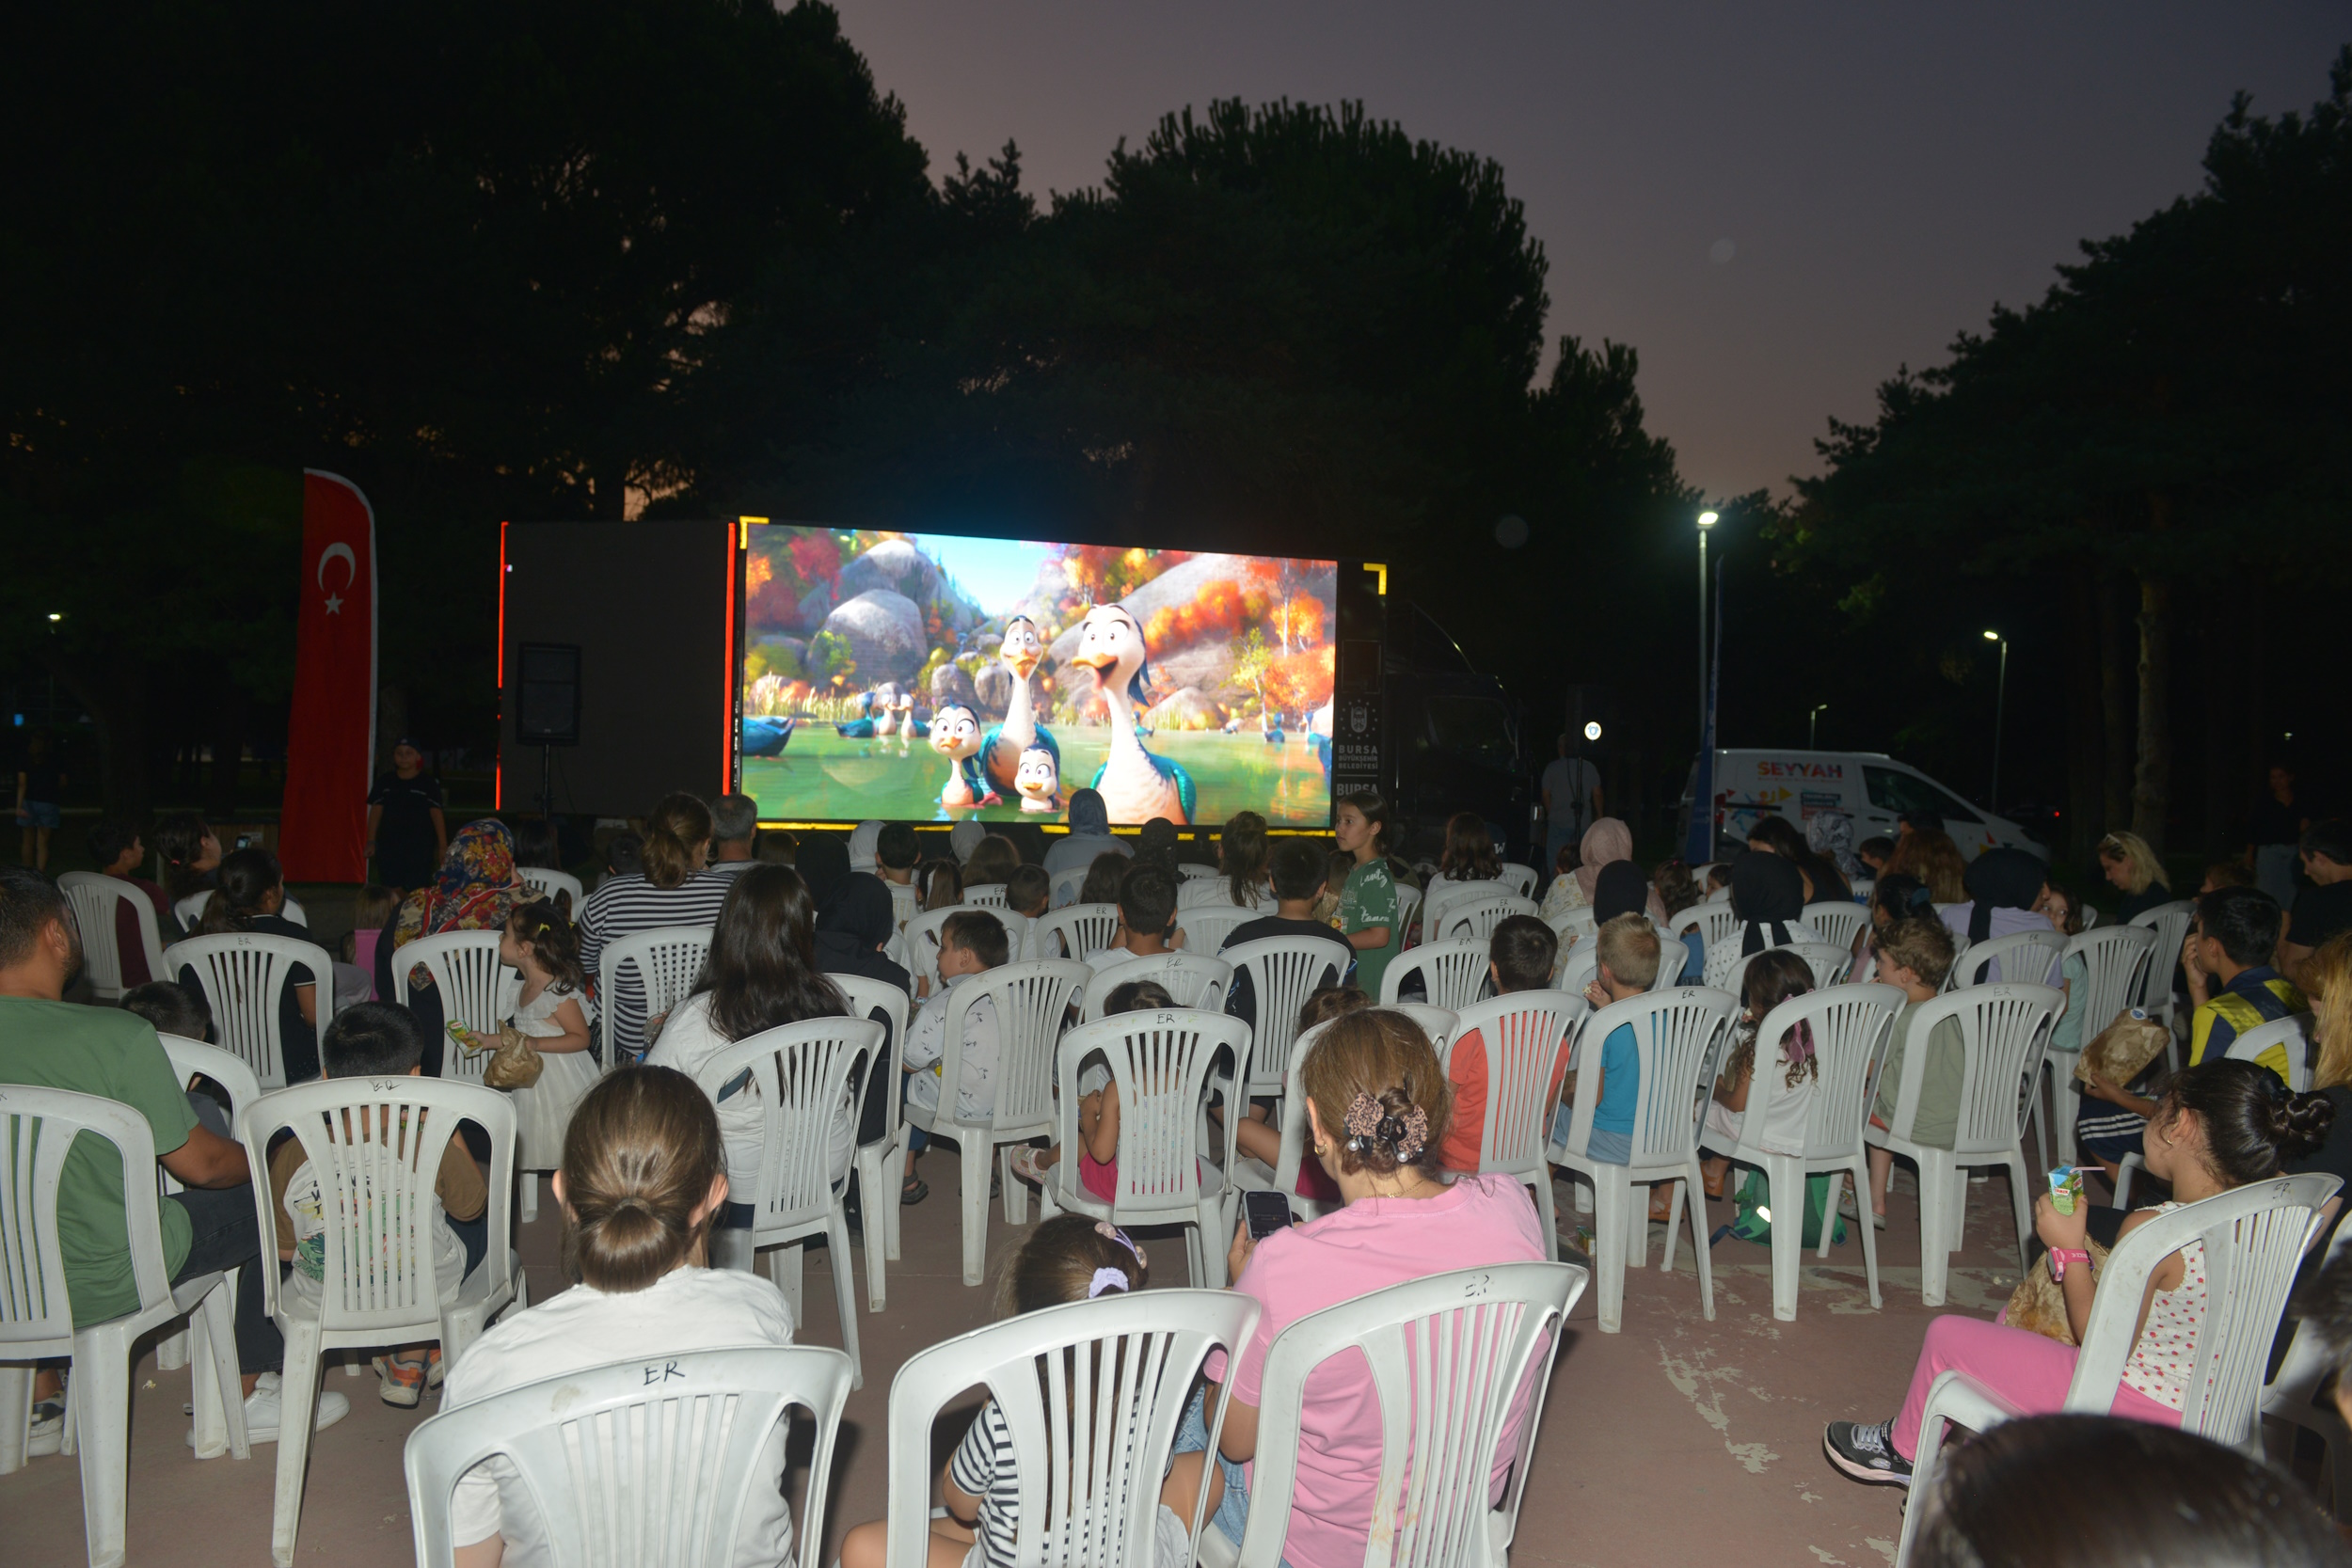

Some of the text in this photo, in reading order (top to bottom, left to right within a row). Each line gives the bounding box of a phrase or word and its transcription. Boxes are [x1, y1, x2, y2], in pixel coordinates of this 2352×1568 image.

[1339, 745, 1377, 753] BURSA
[1757, 761, 1843, 778] SEYYAH
[1096, 906, 1106, 914] ER
[238, 937, 251, 945] ER
[1459, 938, 1471, 946] ER
[1167, 956, 1183, 968] ER
[1682, 990, 1695, 999] ER
[1994, 987, 2011, 997] ER
[1157, 1013, 1175, 1023] ER
[644, 1361, 685, 1386] ER
